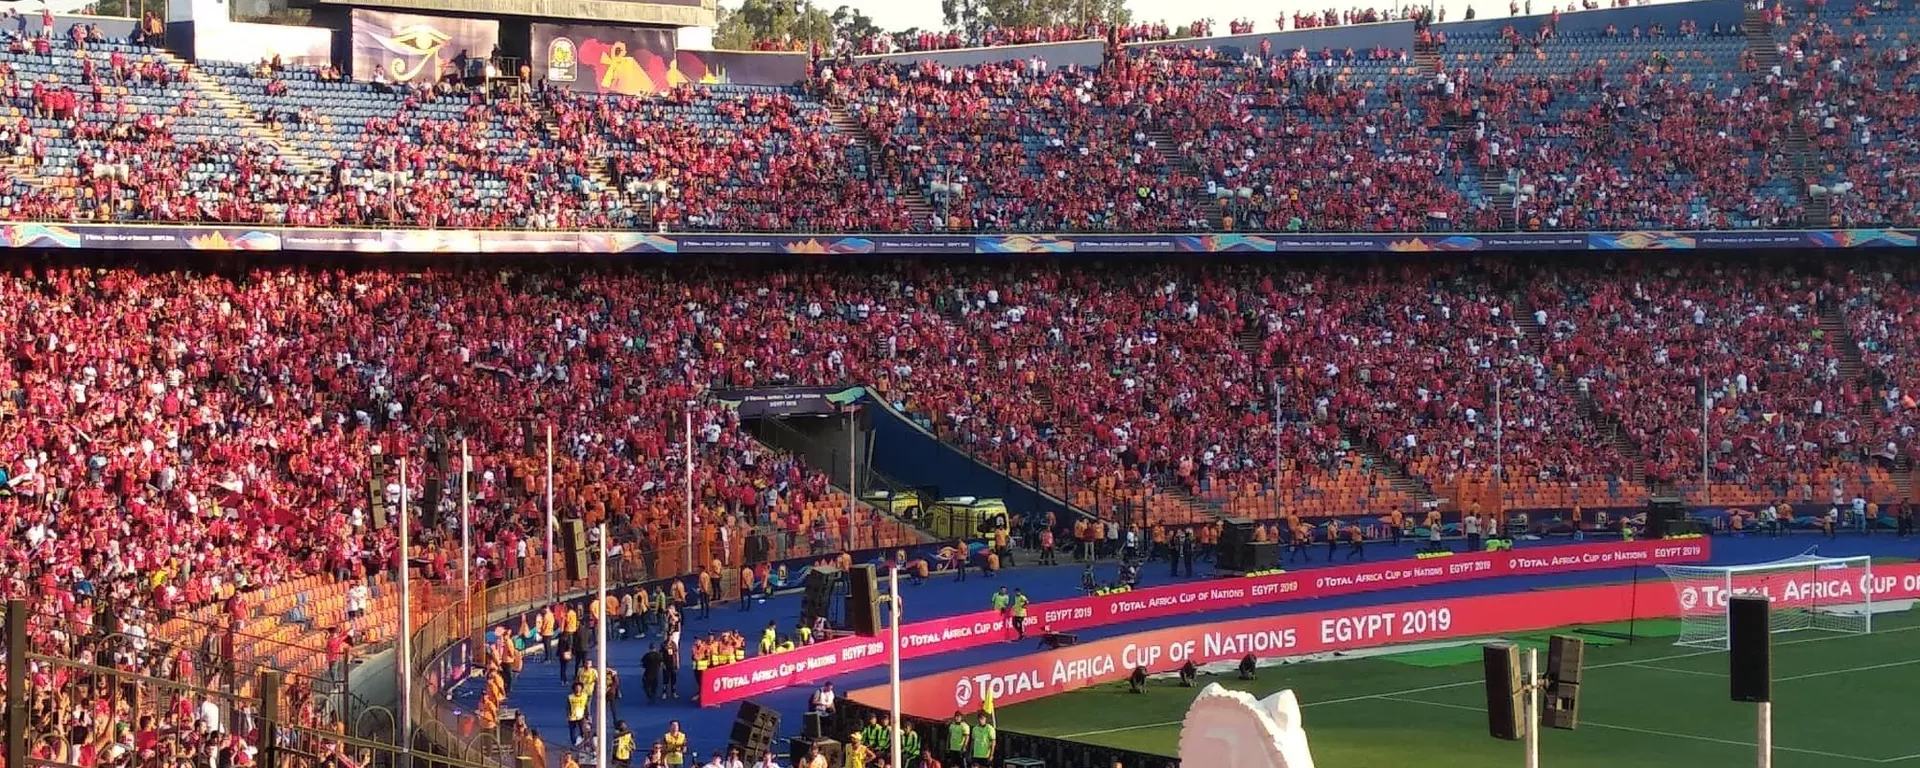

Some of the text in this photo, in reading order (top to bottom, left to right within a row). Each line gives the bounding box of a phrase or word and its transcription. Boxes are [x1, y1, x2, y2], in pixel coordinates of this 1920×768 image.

[1517, 558, 1549, 568] TOTAL
[1551, 556, 1581, 566] AFRICA
[1583, 553, 1600, 563] CUP
[1655, 548, 1681, 558] EGYPT
[1324, 577, 1353, 587] TOTAL
[1356, 573, 1383, 583] AFRICA
[1385, 570, 1401, 579] CUP
[1450, 562, 1474, 574] EGYPT
[1701, 586, 1777, 607] TOL
[1784, 579, 1852, 600] AFRICA
[1860, 572, 1897, 594] CUP
[1119, 601, 1146, 611] TOTAL
[1149, 596, 1177, 607] AFRICA
[1180, 592, 1196, 603] CUP
[1198, 591, 1210, 601] OF
[1211, 588, 1245, 599] NATIONS
[1252, 583, 1279, 596] EGYPT
[910, 633, 940, 646] TOTAL
[974, 622, 991, 635] CUP
[1045, 608, 1073, 622] EGYPT
[1074, 606, 1092, 619] 2019
[974, 608, 1450, 702] TOTAL AFRICA CUP OF NATIONS EGYPT 2019
